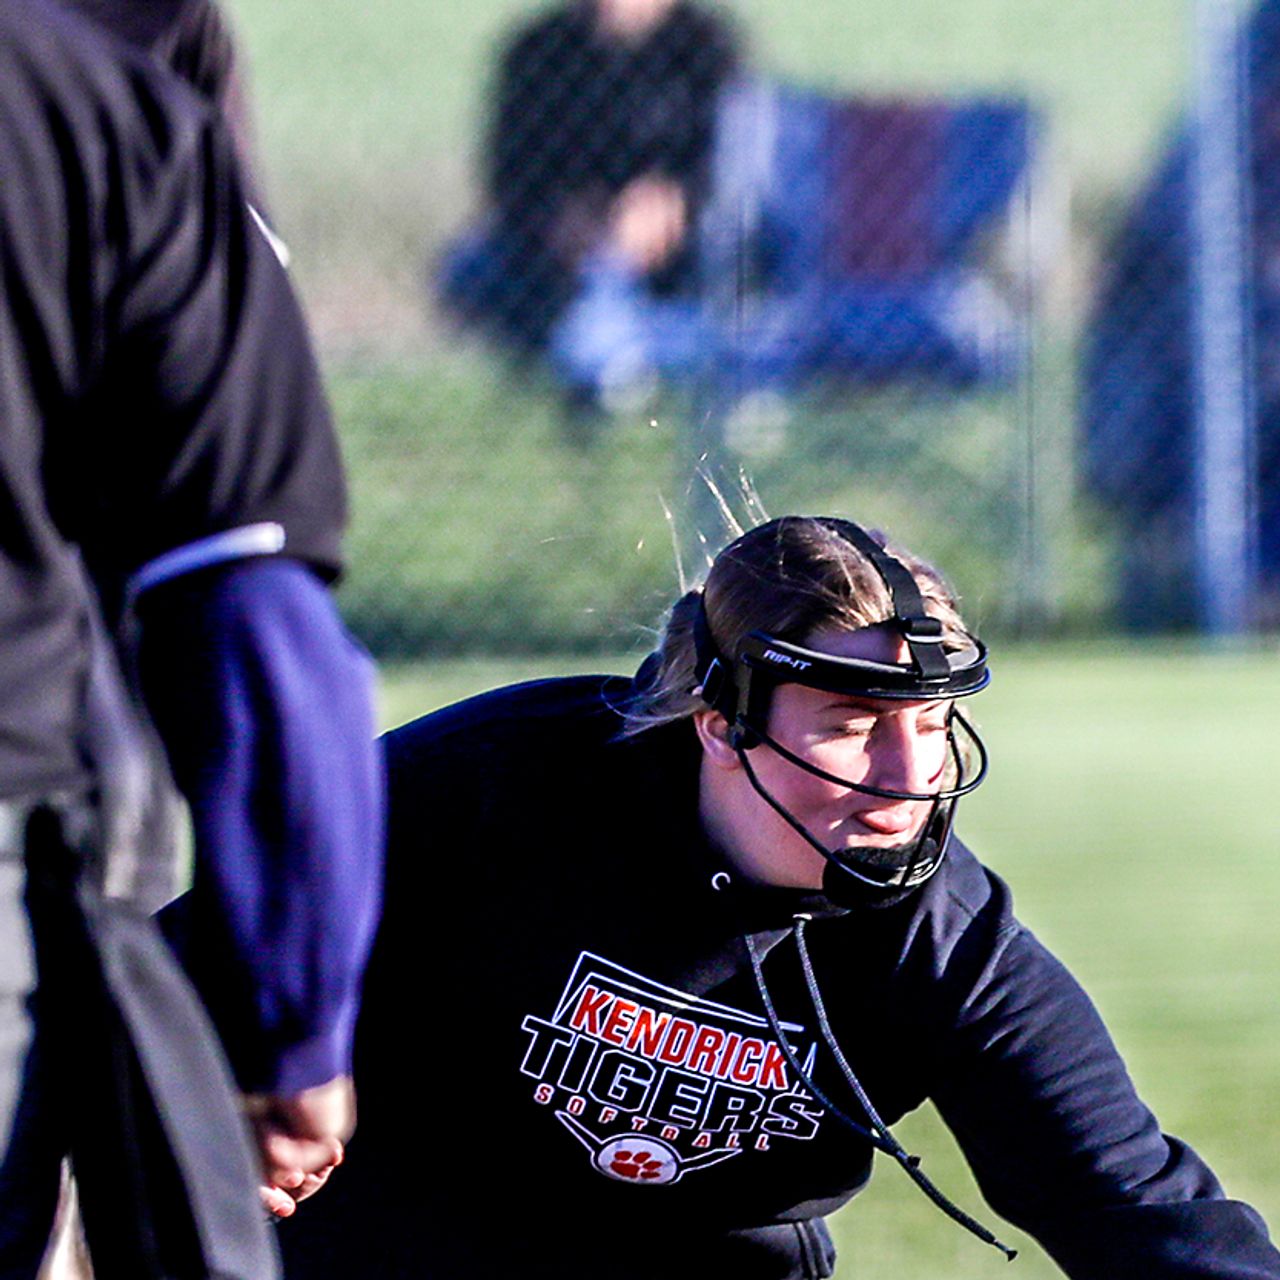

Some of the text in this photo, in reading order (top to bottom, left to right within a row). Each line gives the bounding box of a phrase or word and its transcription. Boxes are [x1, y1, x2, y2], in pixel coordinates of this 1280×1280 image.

[763, 649, 812, 670] RIP-IT
[520, 1014, 824, 1140] TIGERS
[568, 984, 789, 1091] KENDRICK
[533, 1082, 770, 1151] SOFTBALL
